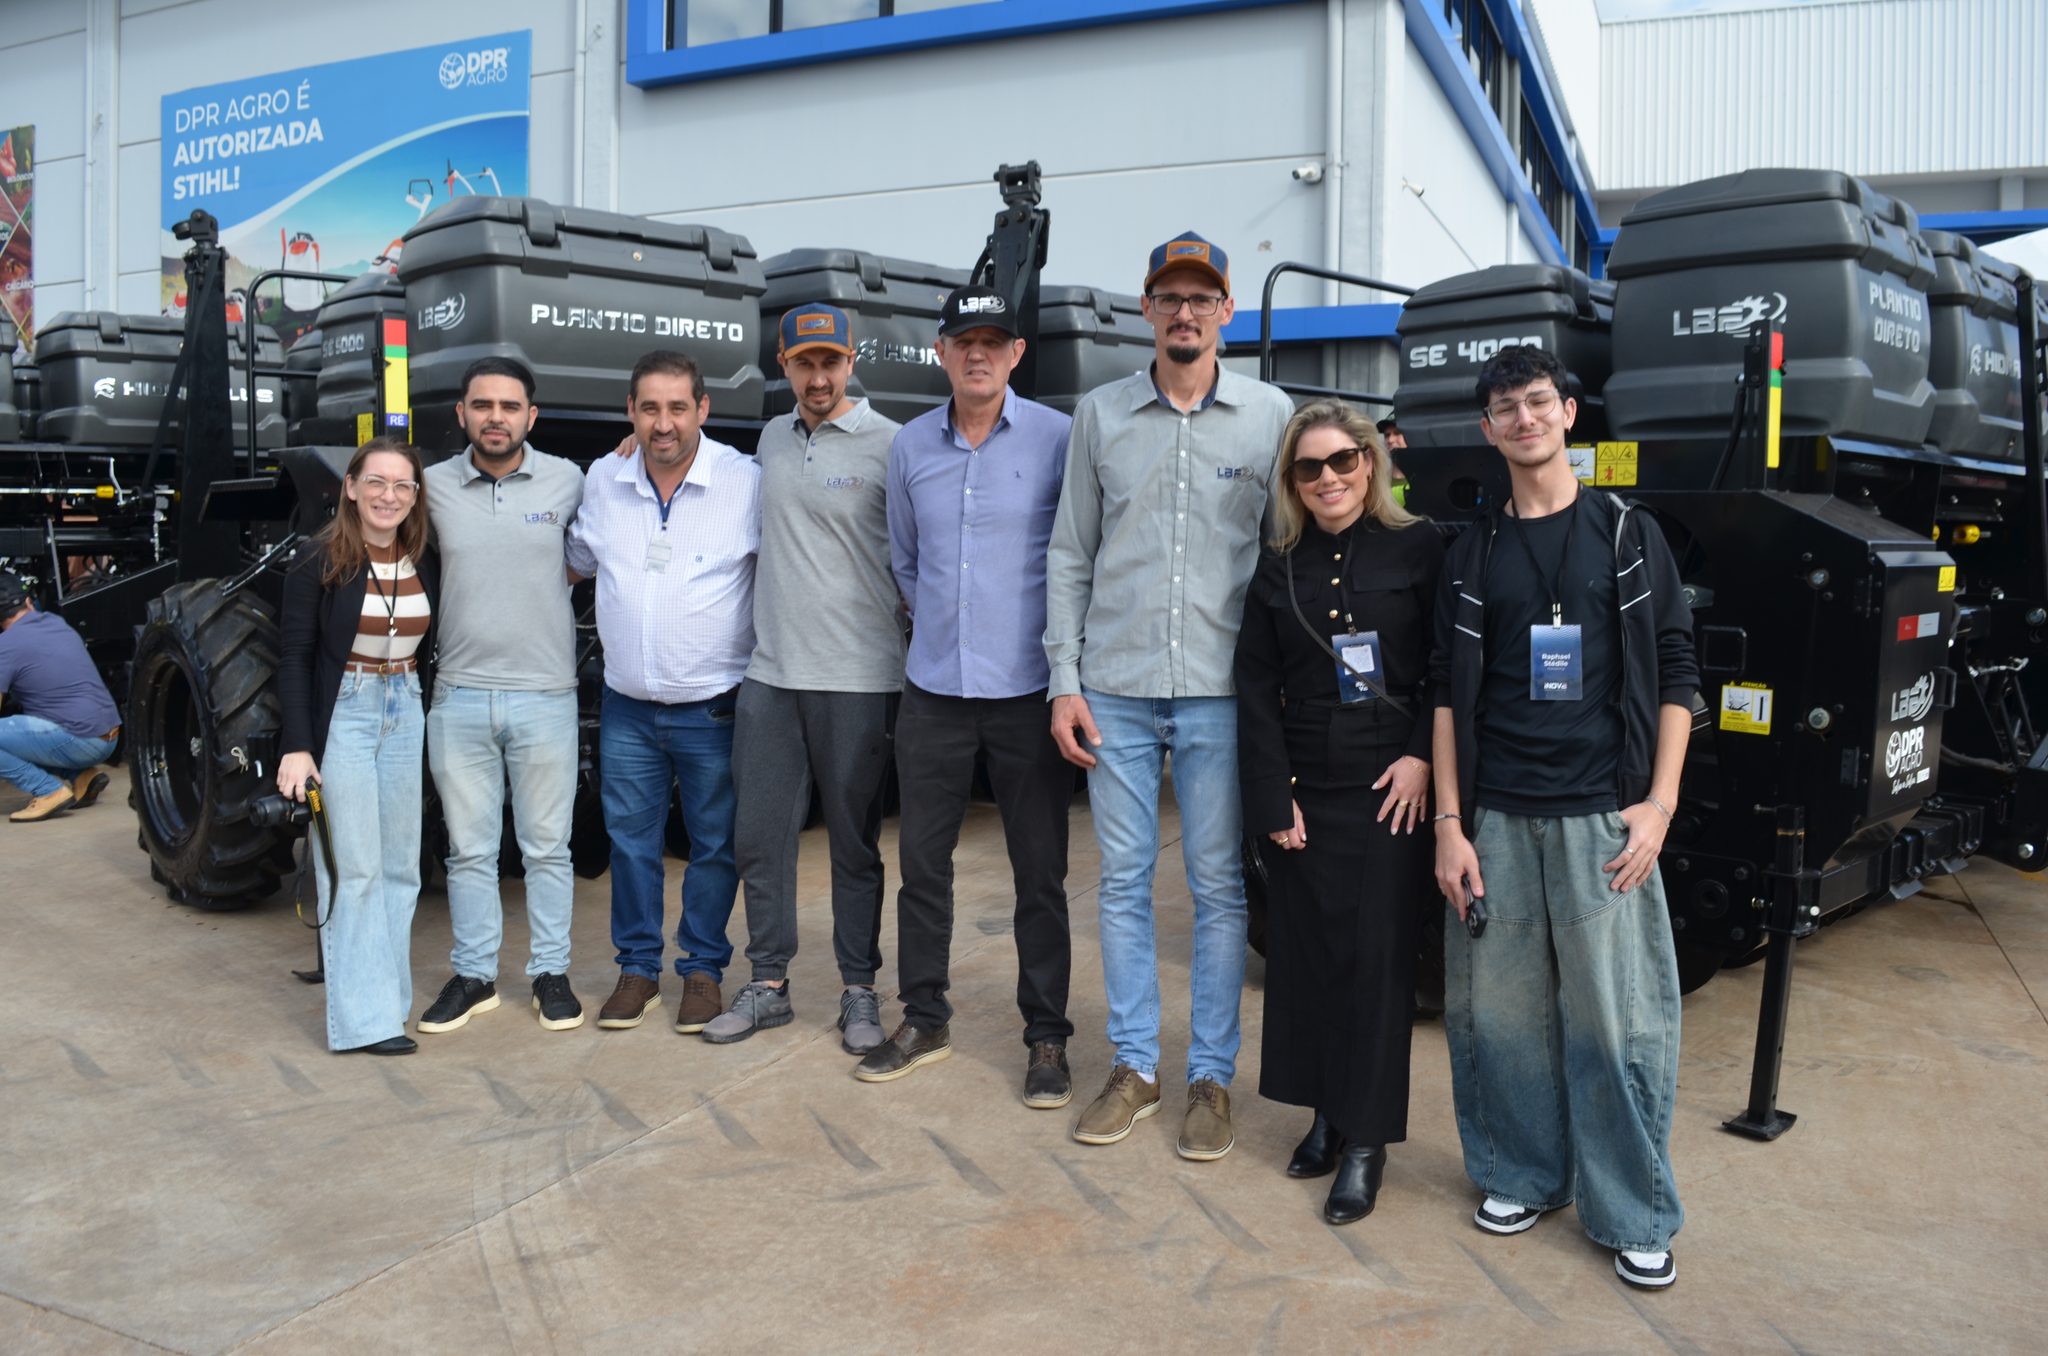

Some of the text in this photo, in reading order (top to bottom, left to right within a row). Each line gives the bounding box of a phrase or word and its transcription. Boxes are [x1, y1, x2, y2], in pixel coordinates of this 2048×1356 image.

[467, 48, 508, 74] DPR
[466, 67, 508, 87] AGRO
[176, 78, 311, 133] DPR AGRO É
[173, 117, 324, 168] AUTORIZADA
[173, 165, 240, 200] STIHL!
[1869, 281, 1922, 322] PLANTIO
[531, 303, 744, 342] PLANTIO DIRETO
[1874, 315, 1920, 353] DIRETO
[335, 333, 364, 355] 5000
[1410, 343, 1448, 369] SE
[390, 412, 405, 427] RÉ
[1542, 653, 1571, 661] Raphael
[1901, 725, 1925, 758] DPR
[1900, 750, 1923, 775] AGRO
